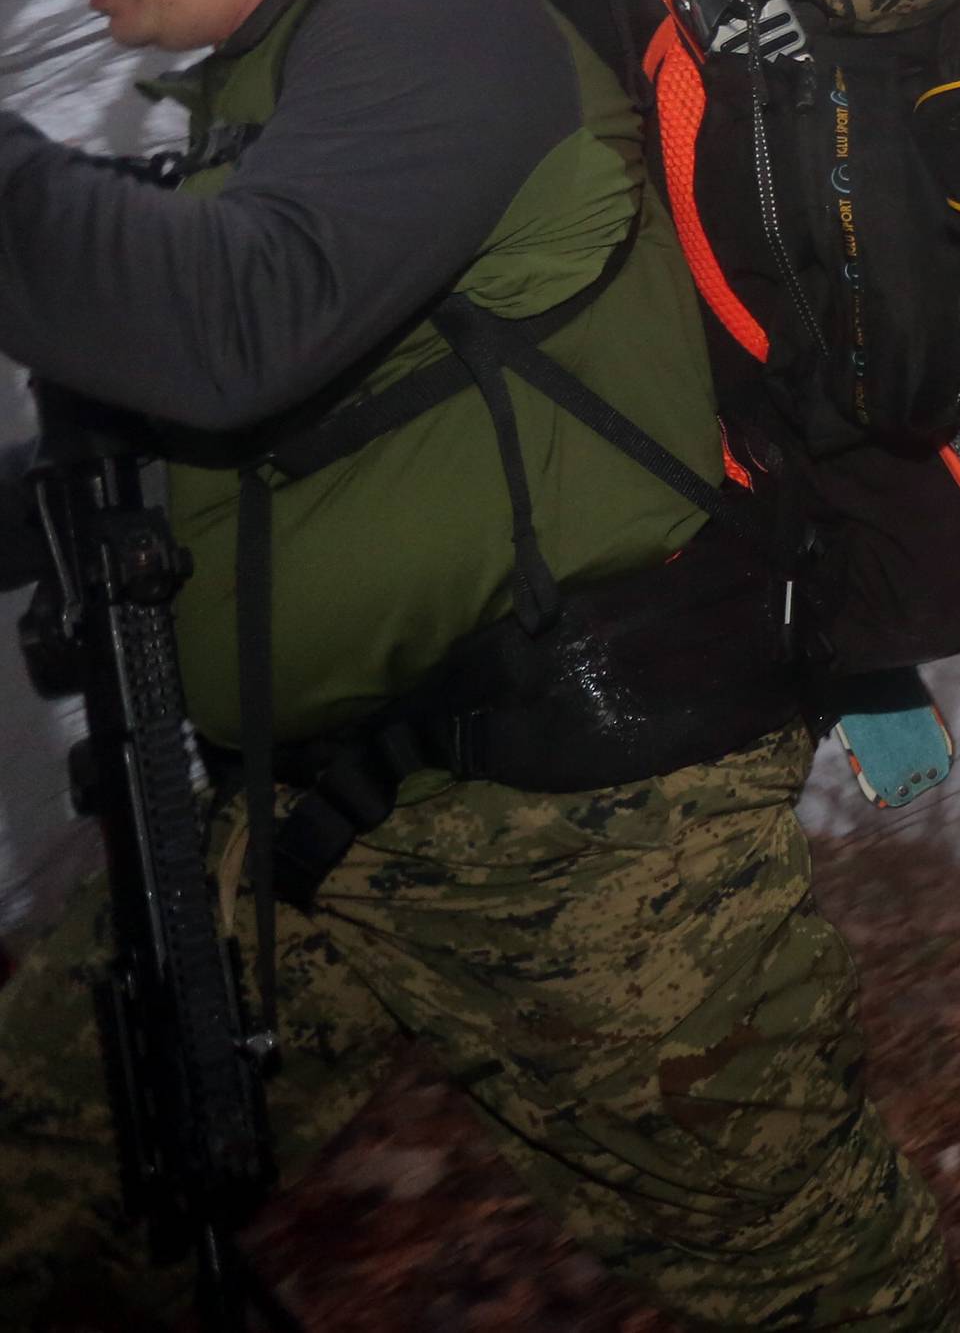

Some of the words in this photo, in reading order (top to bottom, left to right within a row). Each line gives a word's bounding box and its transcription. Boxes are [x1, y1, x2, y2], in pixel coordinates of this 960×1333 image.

[835, 107, 849, 135] SPORT
[836, 135, 849, 158] IGLU
[839, 199, 854, 233] SPORT
